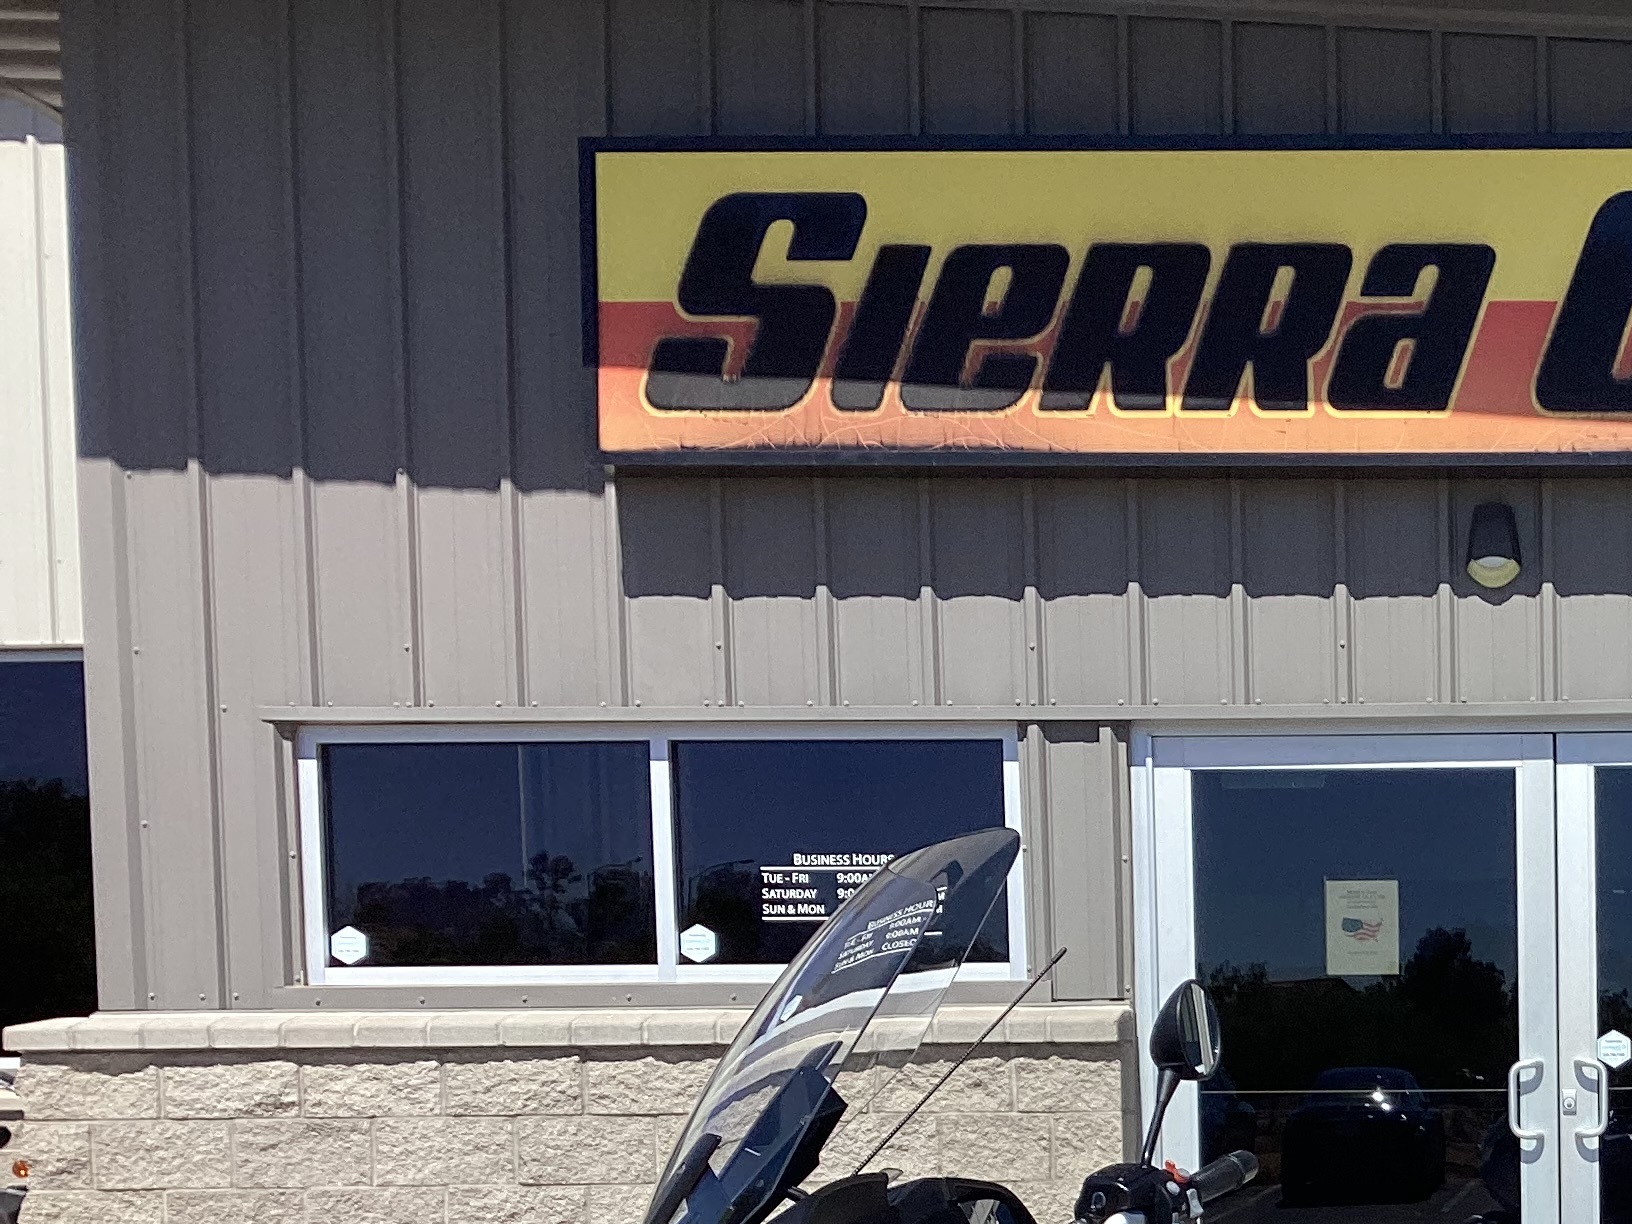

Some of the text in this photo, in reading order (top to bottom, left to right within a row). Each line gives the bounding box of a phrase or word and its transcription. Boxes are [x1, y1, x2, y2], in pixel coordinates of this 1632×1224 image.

[793, 854, 850, 865] BUSINESS
[761, 873, 783, 883] TUE
[792, 873, 809, 883] FRI
[762, 888, 817, 898] SATURDAY
[762, 904, 825, 914] SUN & MON
